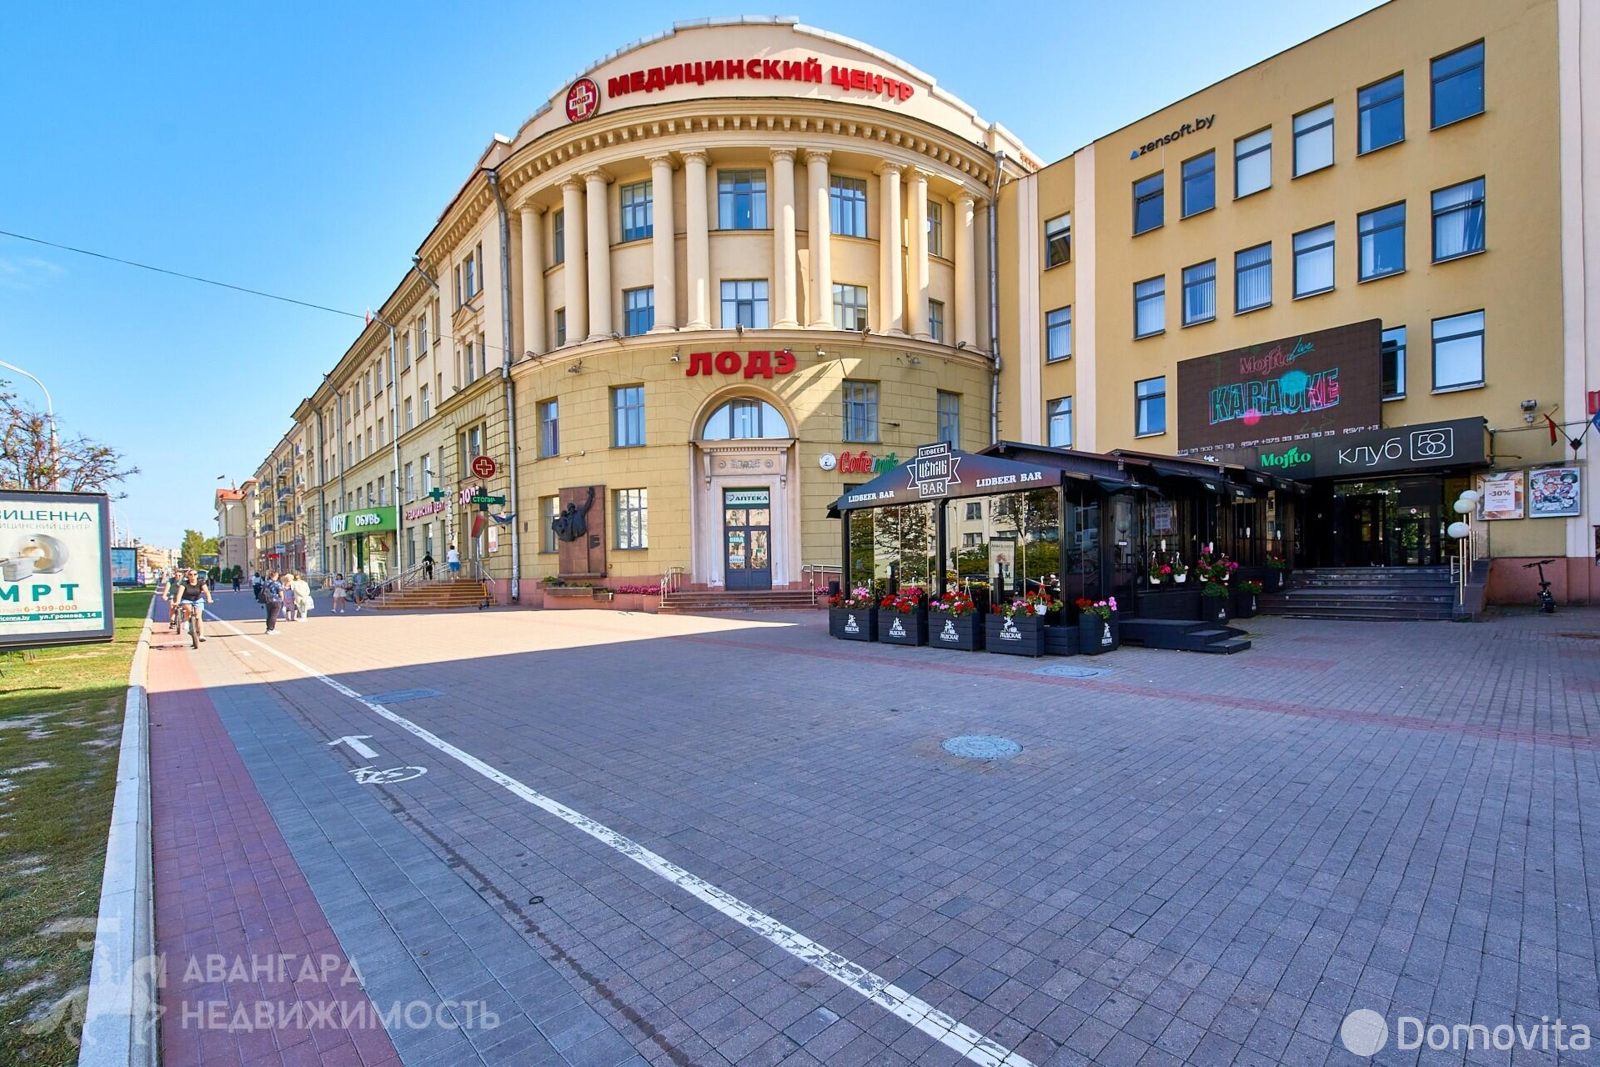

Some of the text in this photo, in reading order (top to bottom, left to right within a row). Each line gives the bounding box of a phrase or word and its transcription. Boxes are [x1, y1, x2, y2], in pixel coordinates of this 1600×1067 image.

[608, 57, 823, 99] МЕДИЦИНСКИЙ
[831, 65, 915, 102] ЦЕНТР
[1139, 114, 1215, 156] zensoft.by
[686, 350, 797, 379] ЛОДЭ
[1240, 345, 1295, 375] Mojito
[1208, 366, 1341, 426] KARAOKE
[920, 447, 945, 456] LIDBEER
[1339, 437, 1402, 466] клуб
[1417, 432, 1446, 456] 58
[1261, 447, 1312, 469] Mojito
[921, 481, 944, 495] BAR
[976, 472, 1042, 487] LIDBEER BAR
[848, 490, 895, 503] LIDBEER BAR
[0, 509, 92, 522] ИЦЕННА
[355, 513, 381, 527] ОБУВЬ
